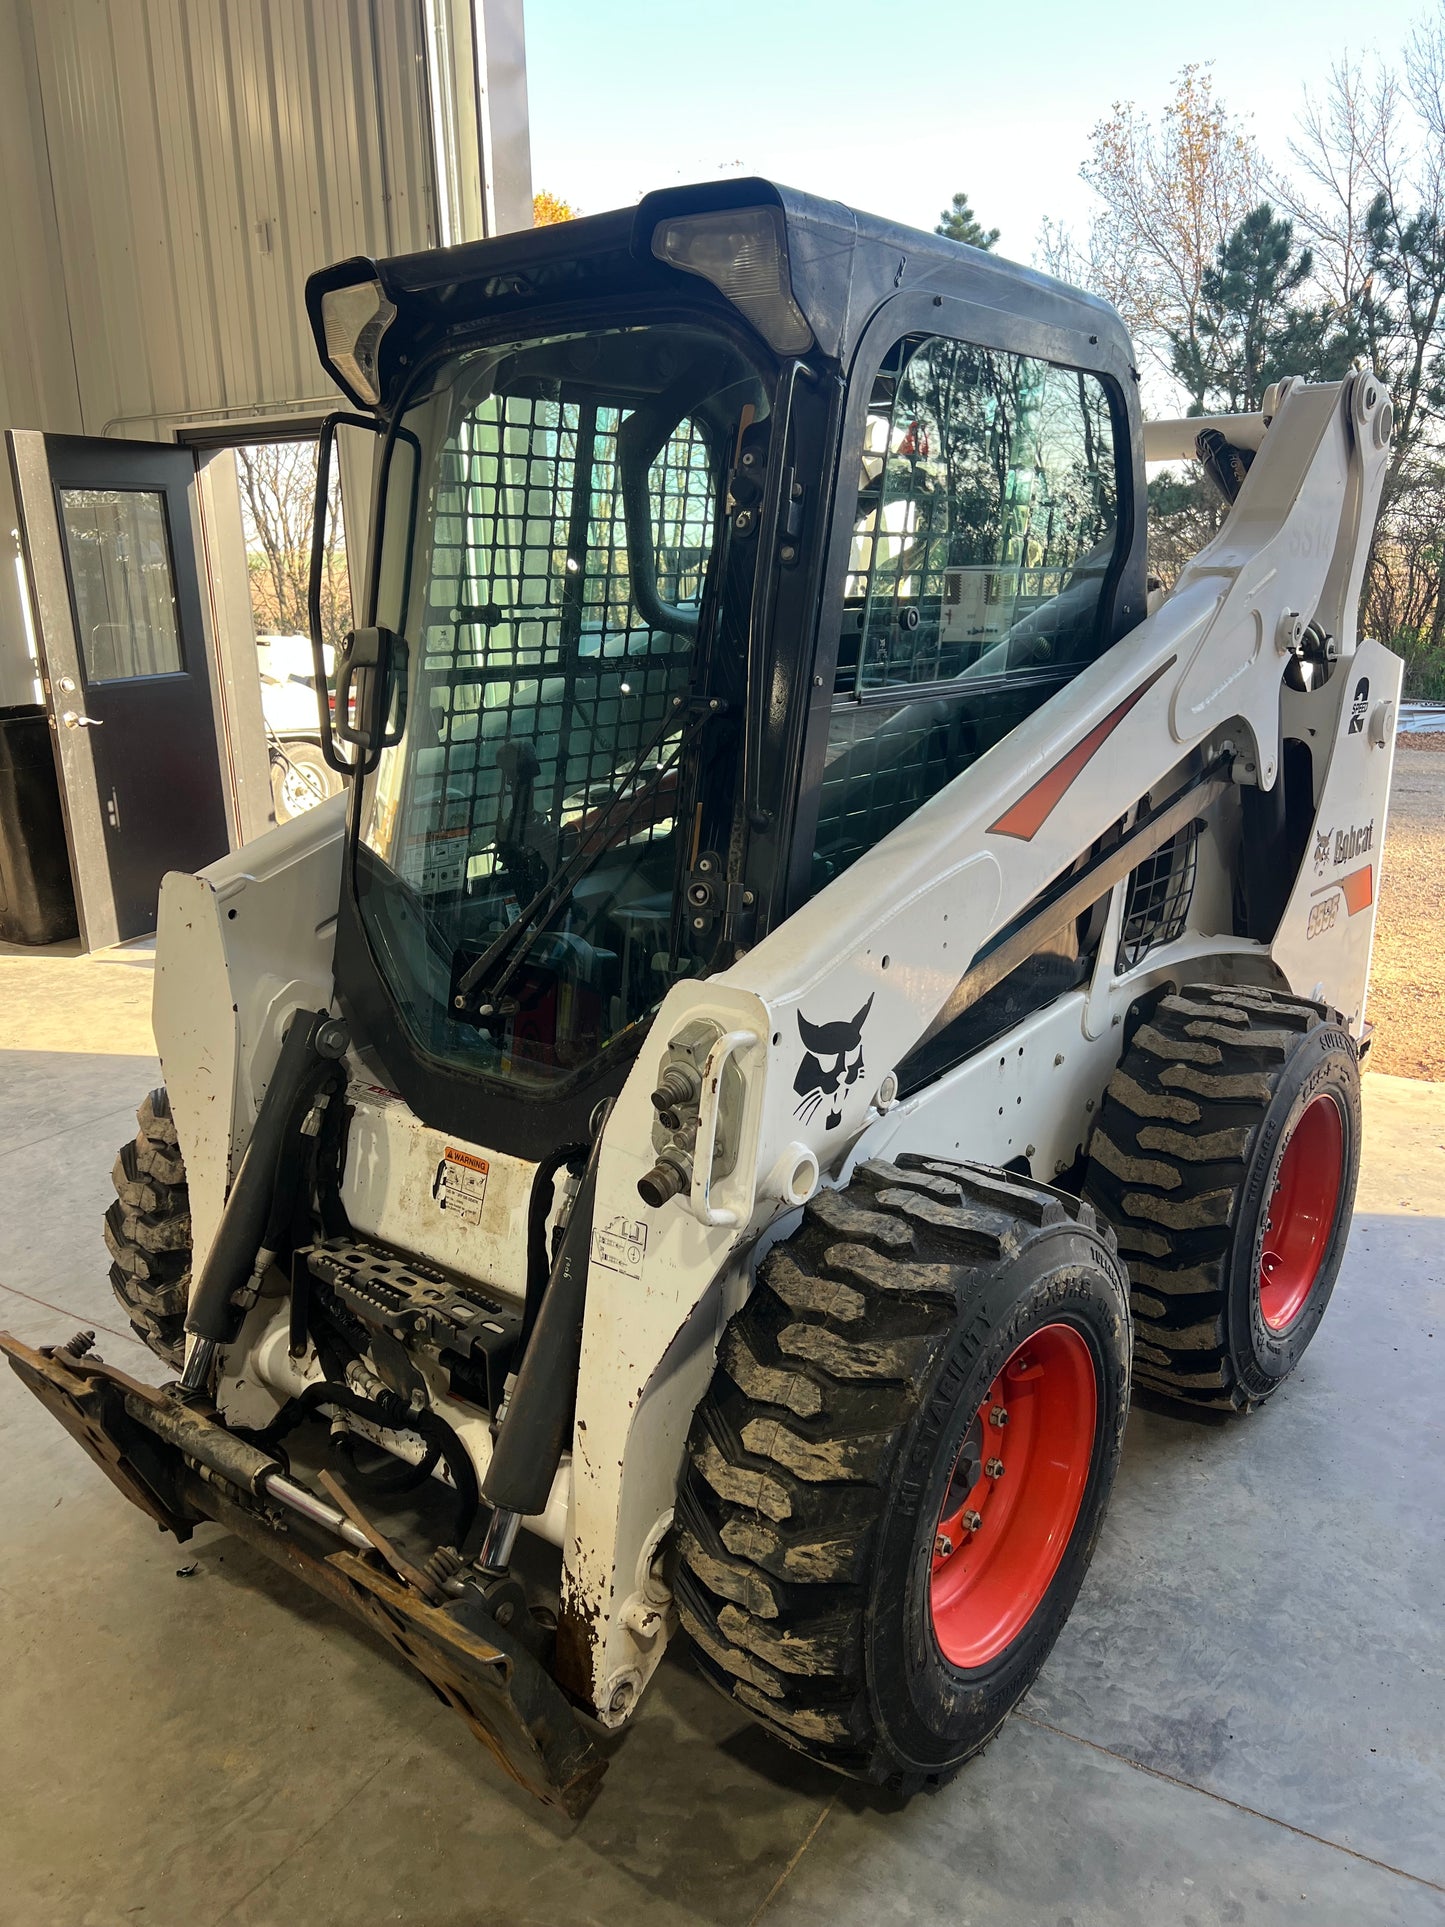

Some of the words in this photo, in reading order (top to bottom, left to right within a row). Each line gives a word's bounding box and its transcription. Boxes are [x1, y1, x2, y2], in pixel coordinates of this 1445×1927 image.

[1333, 822, 1374, 866] Bobcat
[454, 1153, 486, 1171] WARNING
[911, 1303, 992, 1469] STABILITY
